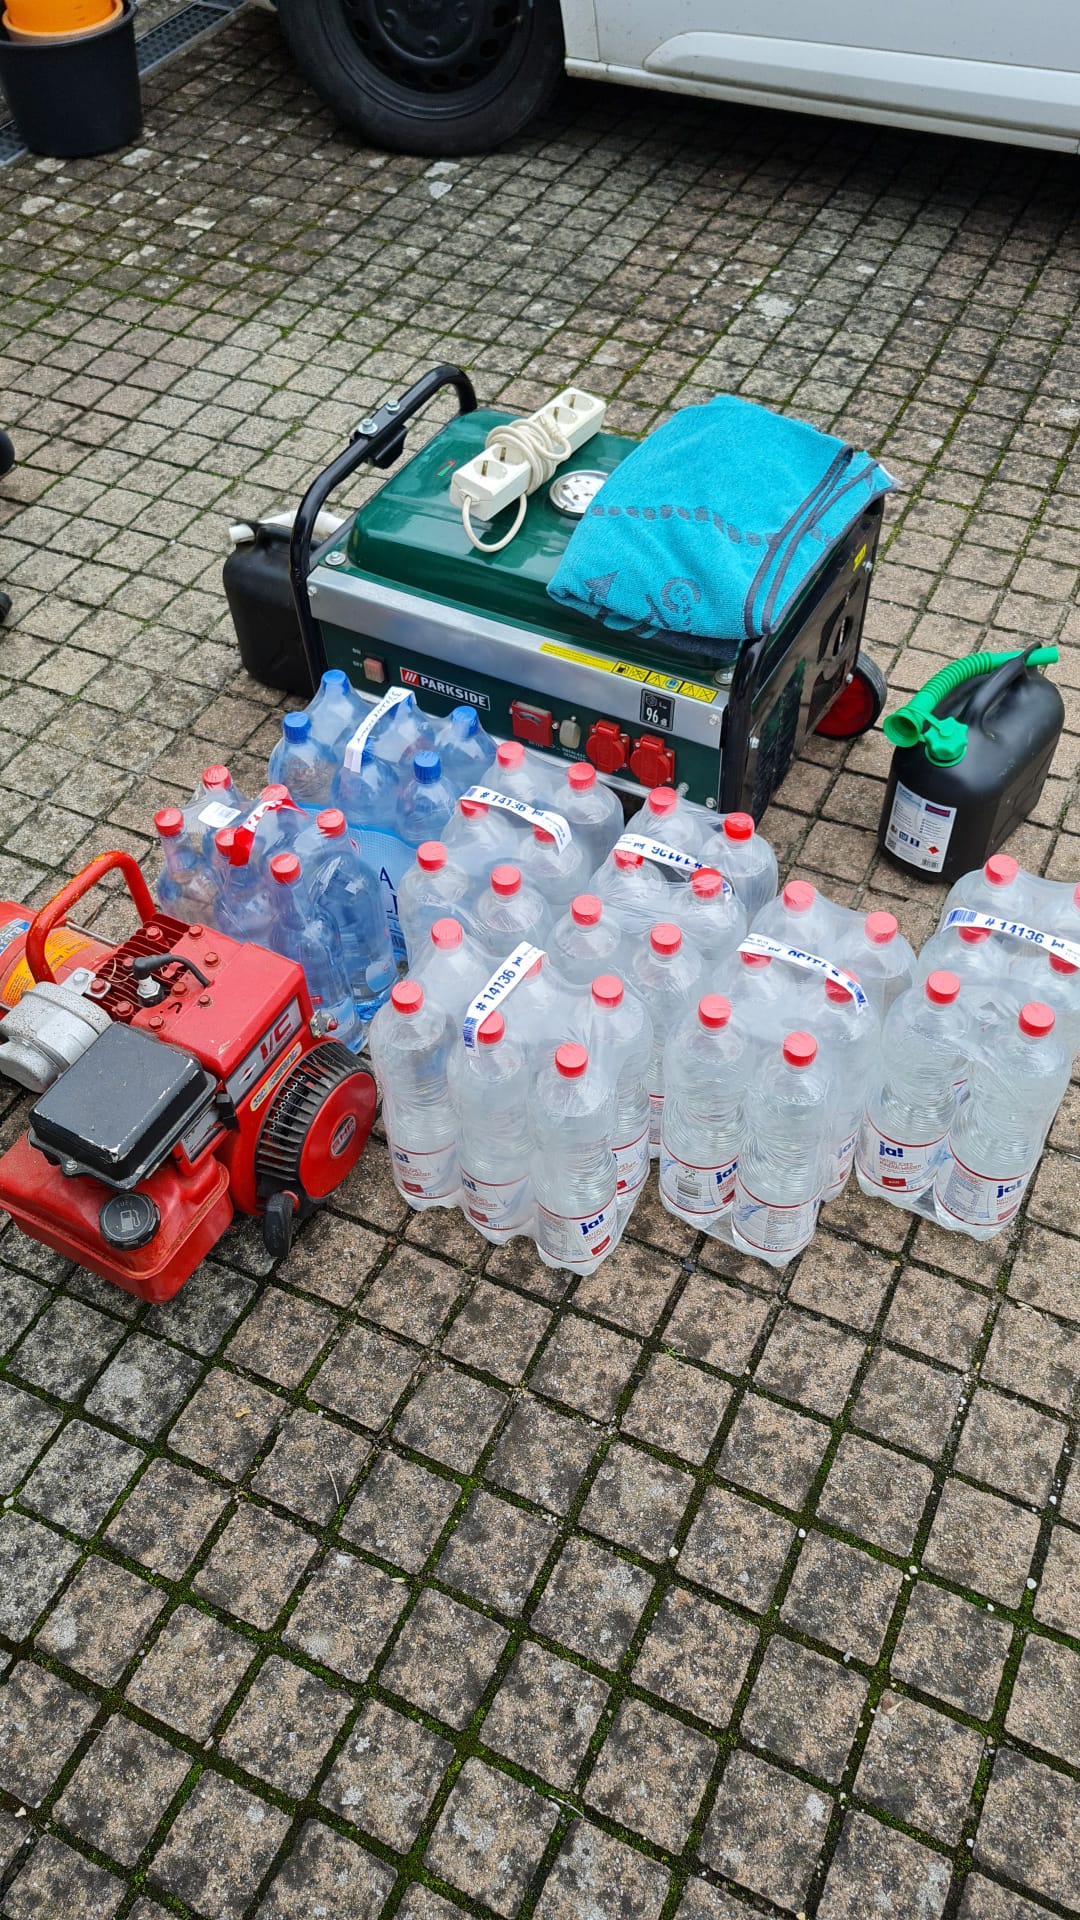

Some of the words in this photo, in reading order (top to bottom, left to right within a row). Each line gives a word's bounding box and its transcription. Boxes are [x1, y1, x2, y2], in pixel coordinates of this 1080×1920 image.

[420, 676, 486, 706] PARKSIDE
[647, 708, 658, 723] 96
[492, 794, 526, 812] 14136
[1000, 922, 1044, 943] 14136
[483, 969, 516, 1001] 14136
[879, 1140, 904, 1158] ja!
[716, 1161, 738, 1184] ja!
[997, 1180, 1022, 1198] ja!
[580, 1214, 604, 1235] ja!
